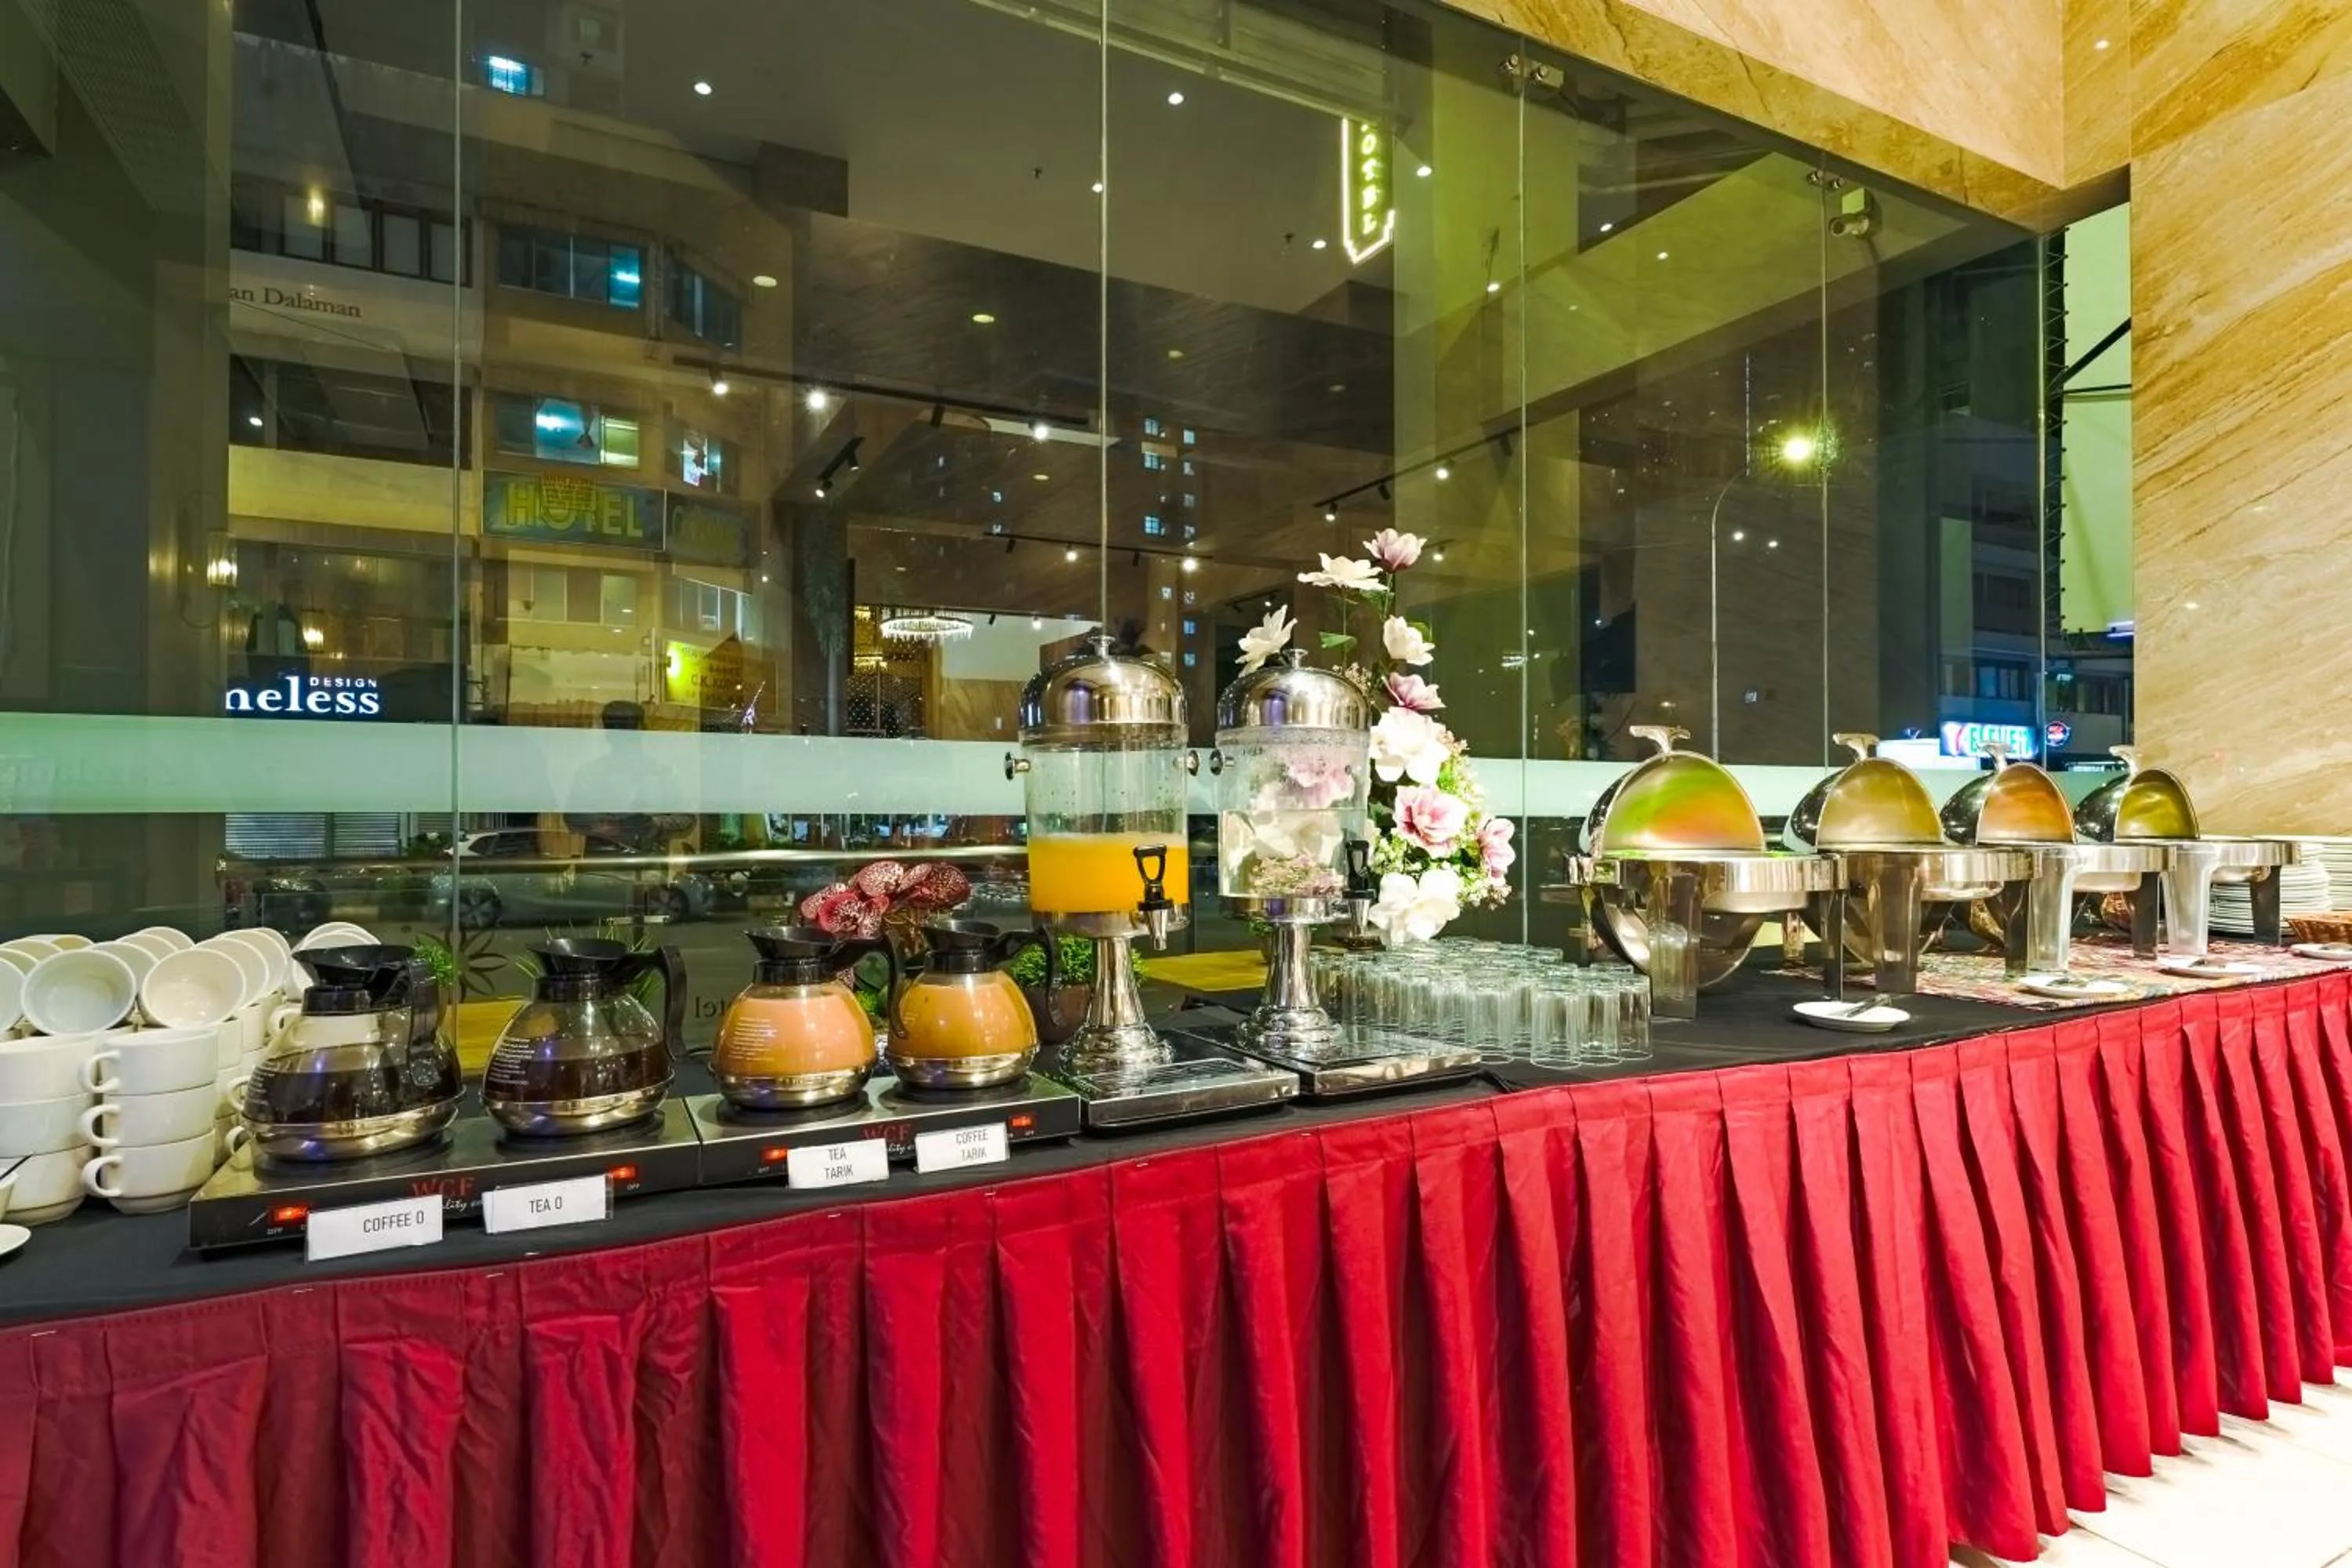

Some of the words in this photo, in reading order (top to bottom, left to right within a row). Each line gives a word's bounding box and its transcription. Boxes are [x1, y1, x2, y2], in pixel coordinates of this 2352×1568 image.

[263, 287, 362, 318] Dalaman
[310, 677, 378, 688] DESIGN
[956, 1128, 989, 1144] COFFEE
[828, 1148, 847, 1161] TEA
[961, 1148, 988, 1161] TARIK
[825, 1164, 854, 1180] TARIK
[529, 1199, 550, 1214] TEA
[363, 1212, 412, 1233] COFFEE
